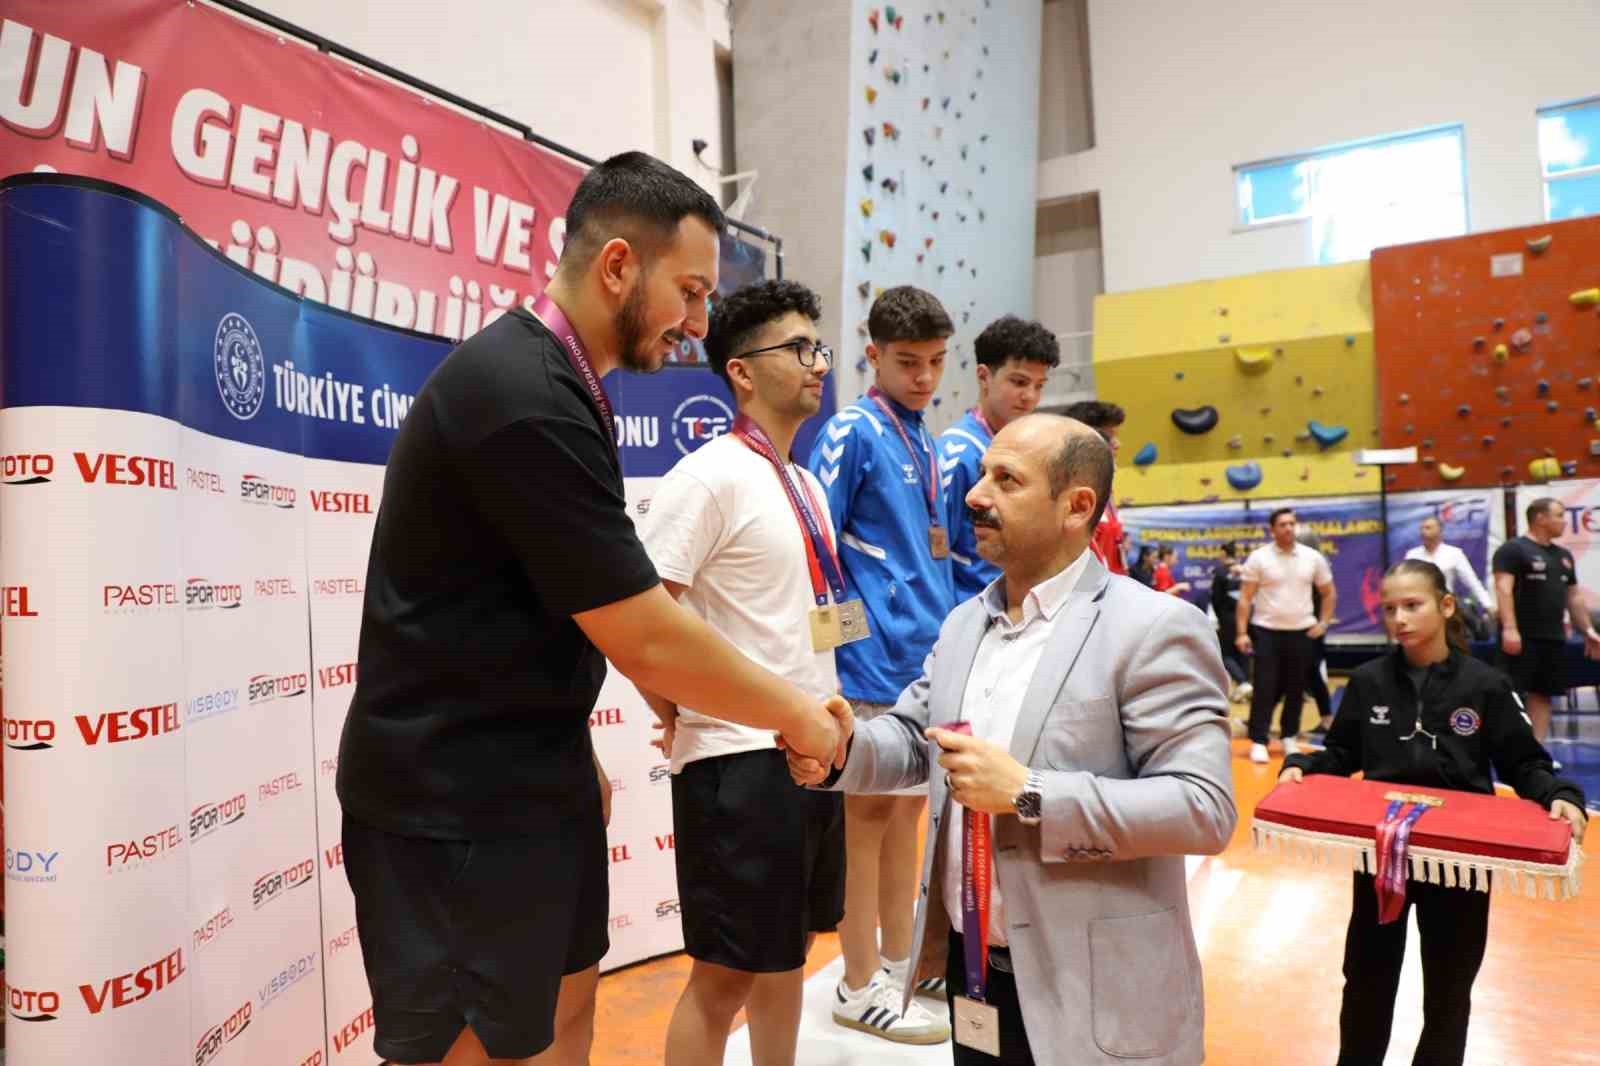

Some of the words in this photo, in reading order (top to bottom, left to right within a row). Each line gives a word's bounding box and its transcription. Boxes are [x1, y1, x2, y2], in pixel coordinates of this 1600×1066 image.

[170, 88, 458, 253] GENÇLİK
[472, 187, 535, 275] VE
[272, 360, 366, 425] TÜRKİYE
[371, 383, 415, 430] CİM
[73, 452, 178, 490] VESTEL
[186, 467, 225, 493] PASTEL
[310, 490, 374, 514] VESTEL
[104, 584, 180, 607] PASTEL
[254, 578, 297, 596] PASTEL
[314, 578, 365, 595] PASTEL
[318, 663, 359, 689] VEST
[74, 702, 182, 746] VESTEL
[257, 772, 303, 801] PASTEL
[106, 823, 183, 867] PASTEL
[192, 907, 234, 950] PASTEL
[79, 947, 186, 1015] VESTEL
